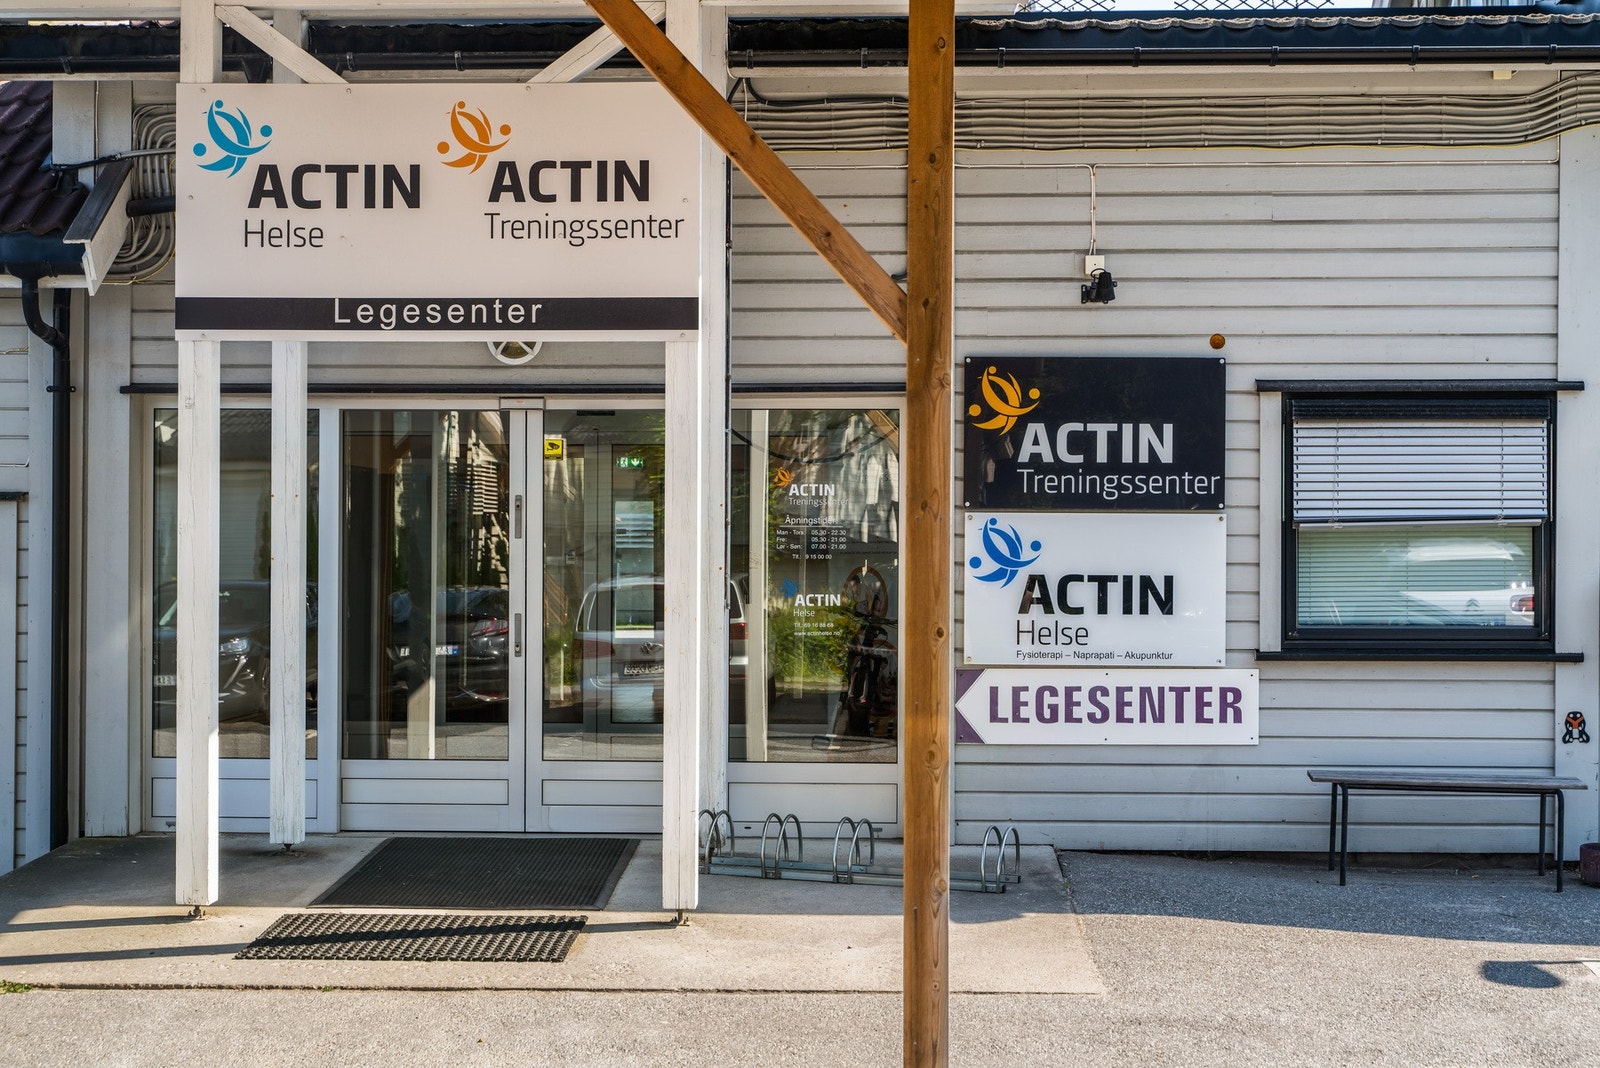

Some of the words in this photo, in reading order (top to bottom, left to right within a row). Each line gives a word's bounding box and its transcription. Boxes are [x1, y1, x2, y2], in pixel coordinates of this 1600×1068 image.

[247, 163, 421, 209] ACTIN
[488, 159, 651, 203] ACTIN
[243, 219, 324, 248] Helse
[484, 212, 685, 247] Treningssenter
[334, 298, 543, 330] Legesenter
[1017, 422, 1174, 464] ACTIN
[788, 483, 835, 496] ACTIN
[1016, 468, 1220, 500] Treningssenter
[789, 498, 849, 507] Treningssnter
[794, 593, 841, 607] ACTIN
[1018, 574, 1174, 616] ACTIN
[793, 608, 816, 617] Helse
[1016, 619, 1089, 646] Helse
[1016, 649, 1063, 661] Fysioterapi
[1073, 649, 1115, 661] Naprapati
[1124, 649, 1173, 661] Akupunktur
[988, 684, 1243, 725] LEGESENTER
